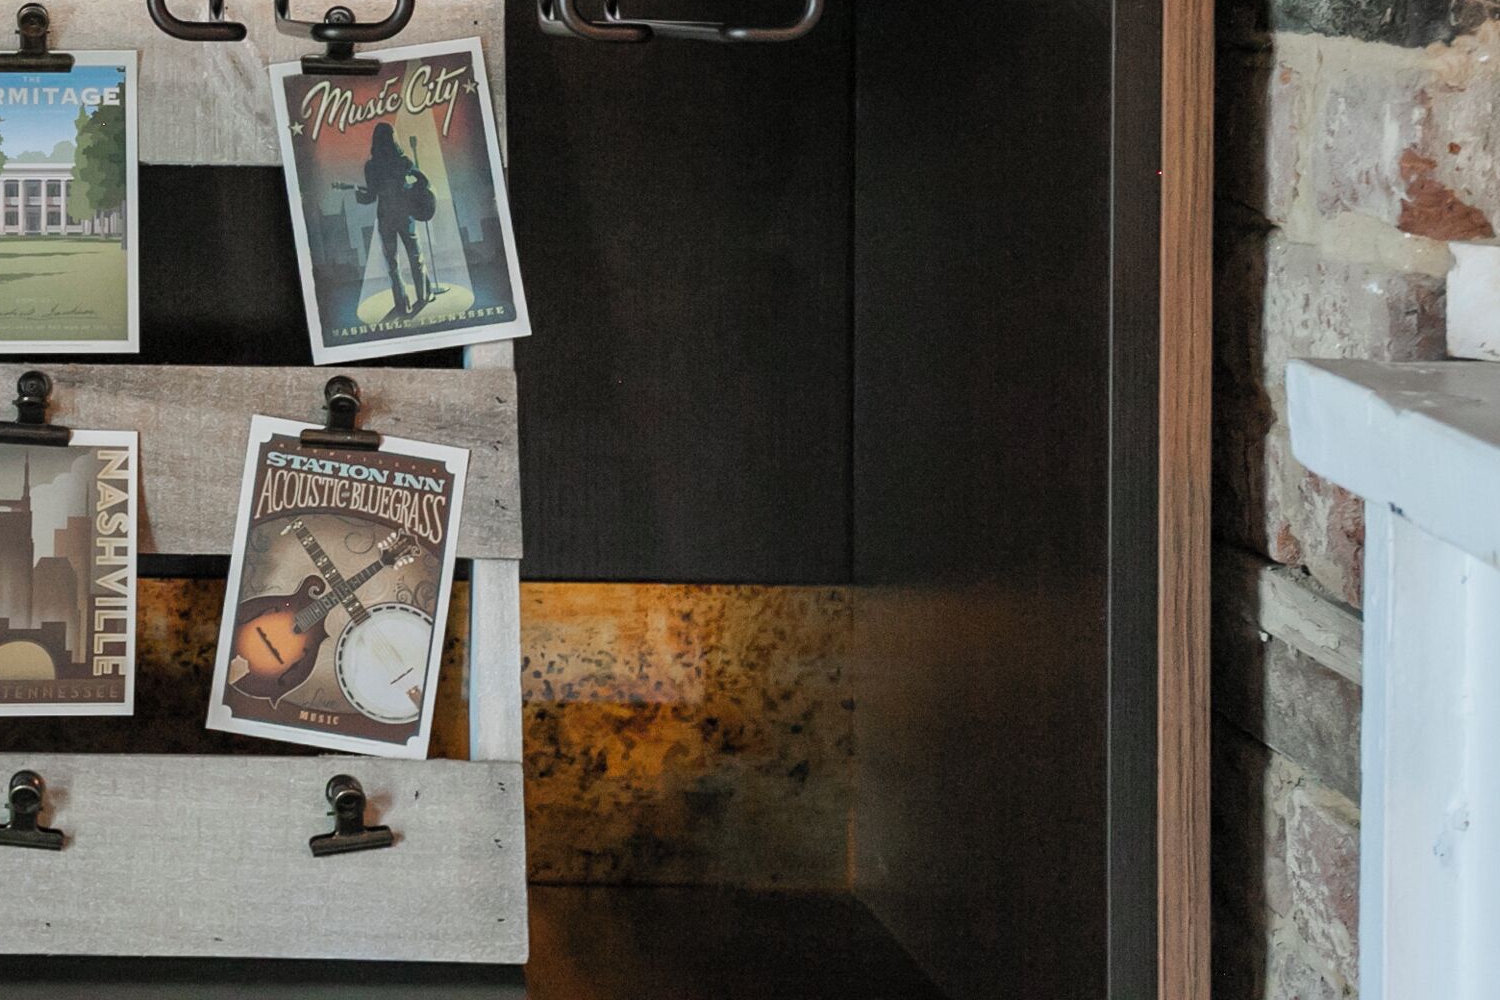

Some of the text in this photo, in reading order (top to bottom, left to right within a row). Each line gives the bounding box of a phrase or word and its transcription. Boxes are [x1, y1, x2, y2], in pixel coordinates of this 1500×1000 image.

[302, 65, 467, 140] Music City
[332, 305, 505, 337] NASHVILLE TENNESSEE
[266, 451, 445, 493] STATION INN
[254, 468, 446, 545] ACOUSTIC BLUEGRASS
[92, 450, 129, 677] NASHVILLE
[3, 681, 119, 699] TENNESSEE
[299, 710, 340, 725] MUSIC
